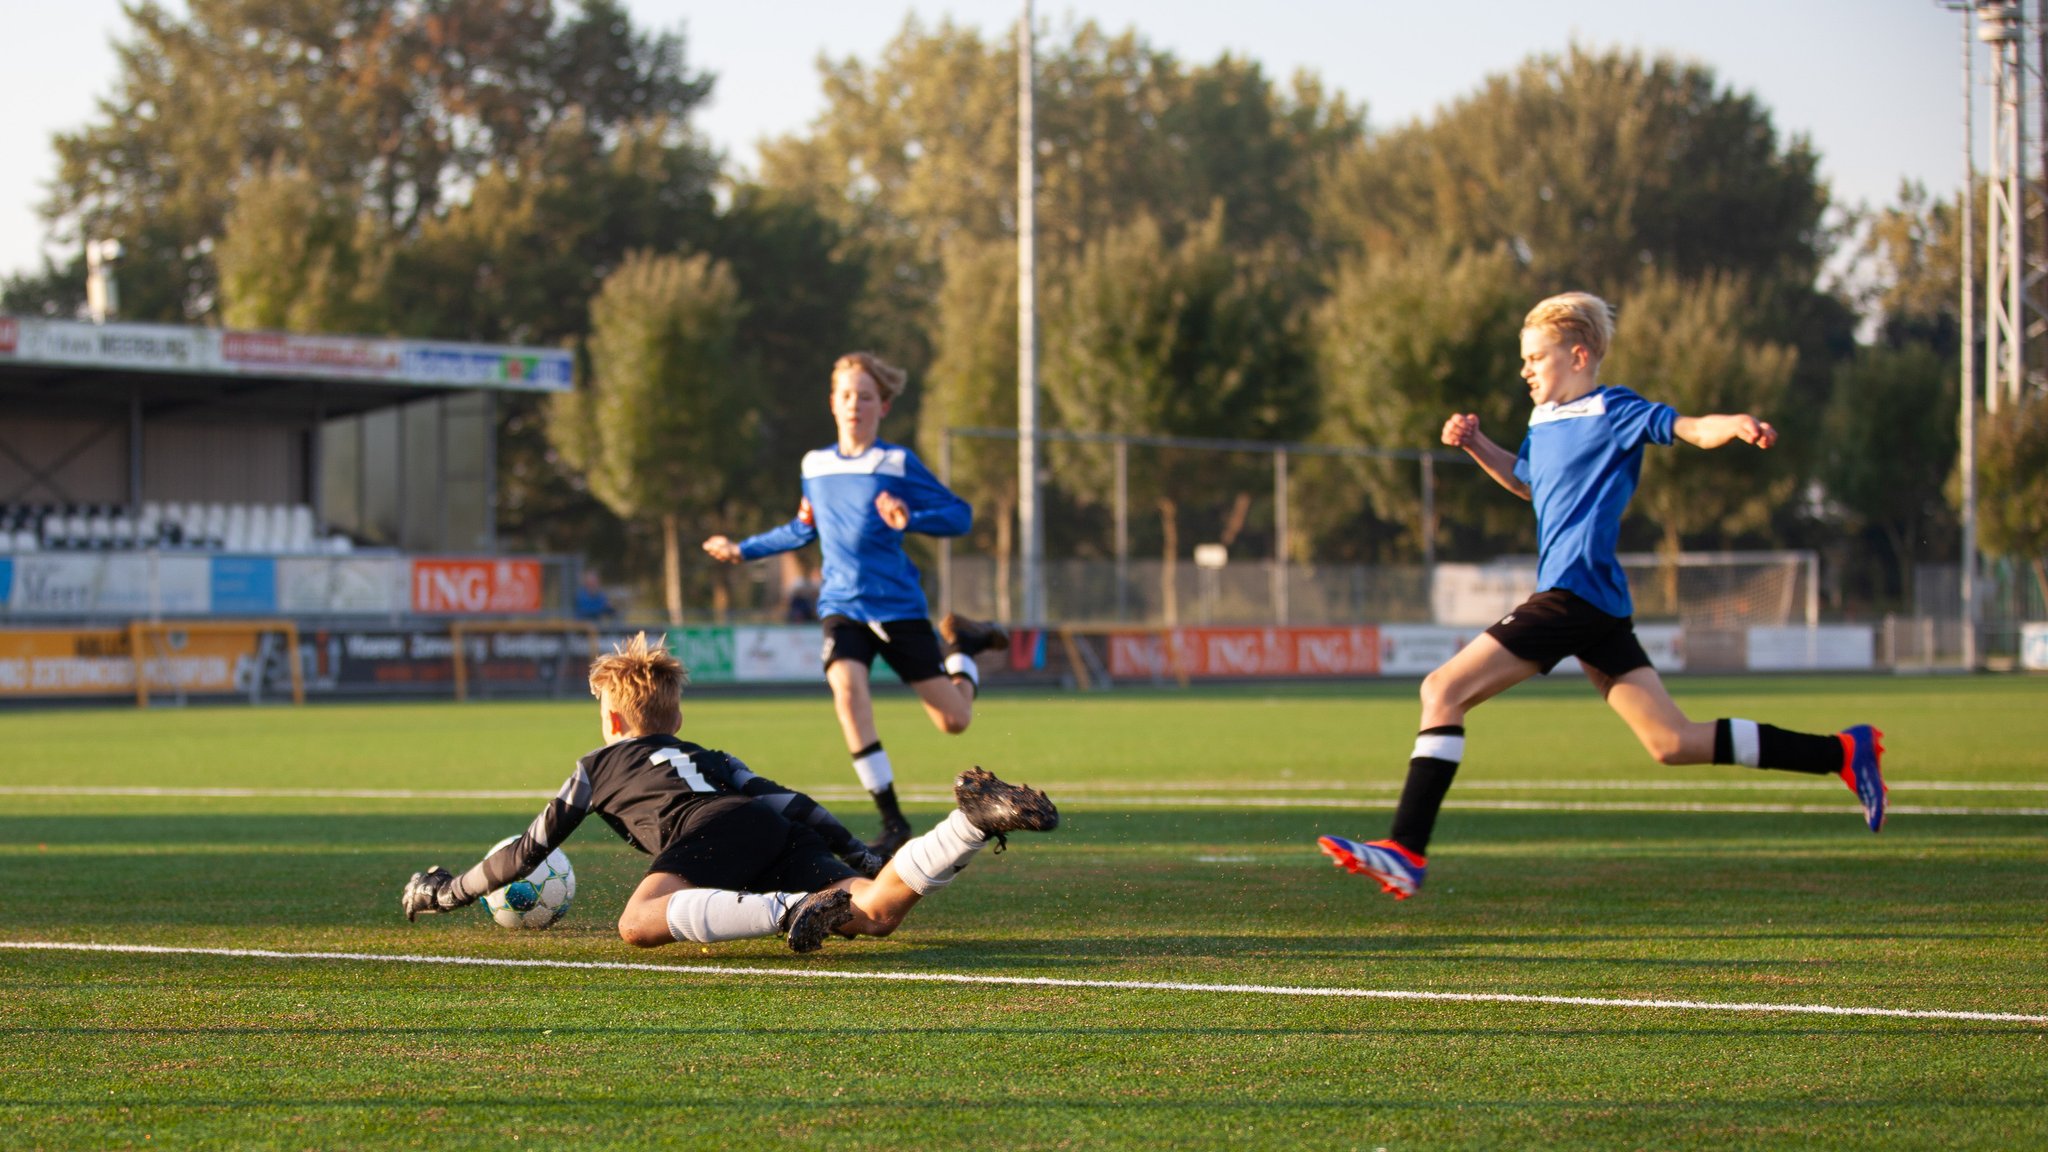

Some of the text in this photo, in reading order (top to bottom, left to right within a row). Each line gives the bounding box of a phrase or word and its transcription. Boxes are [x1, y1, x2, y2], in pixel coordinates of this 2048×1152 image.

[418, 567, 489, 612] ING
[1207, 634, 1261, 674] ING
[1298, 634, 1350, 673] ING
[649, 747, 717, 792] 1
